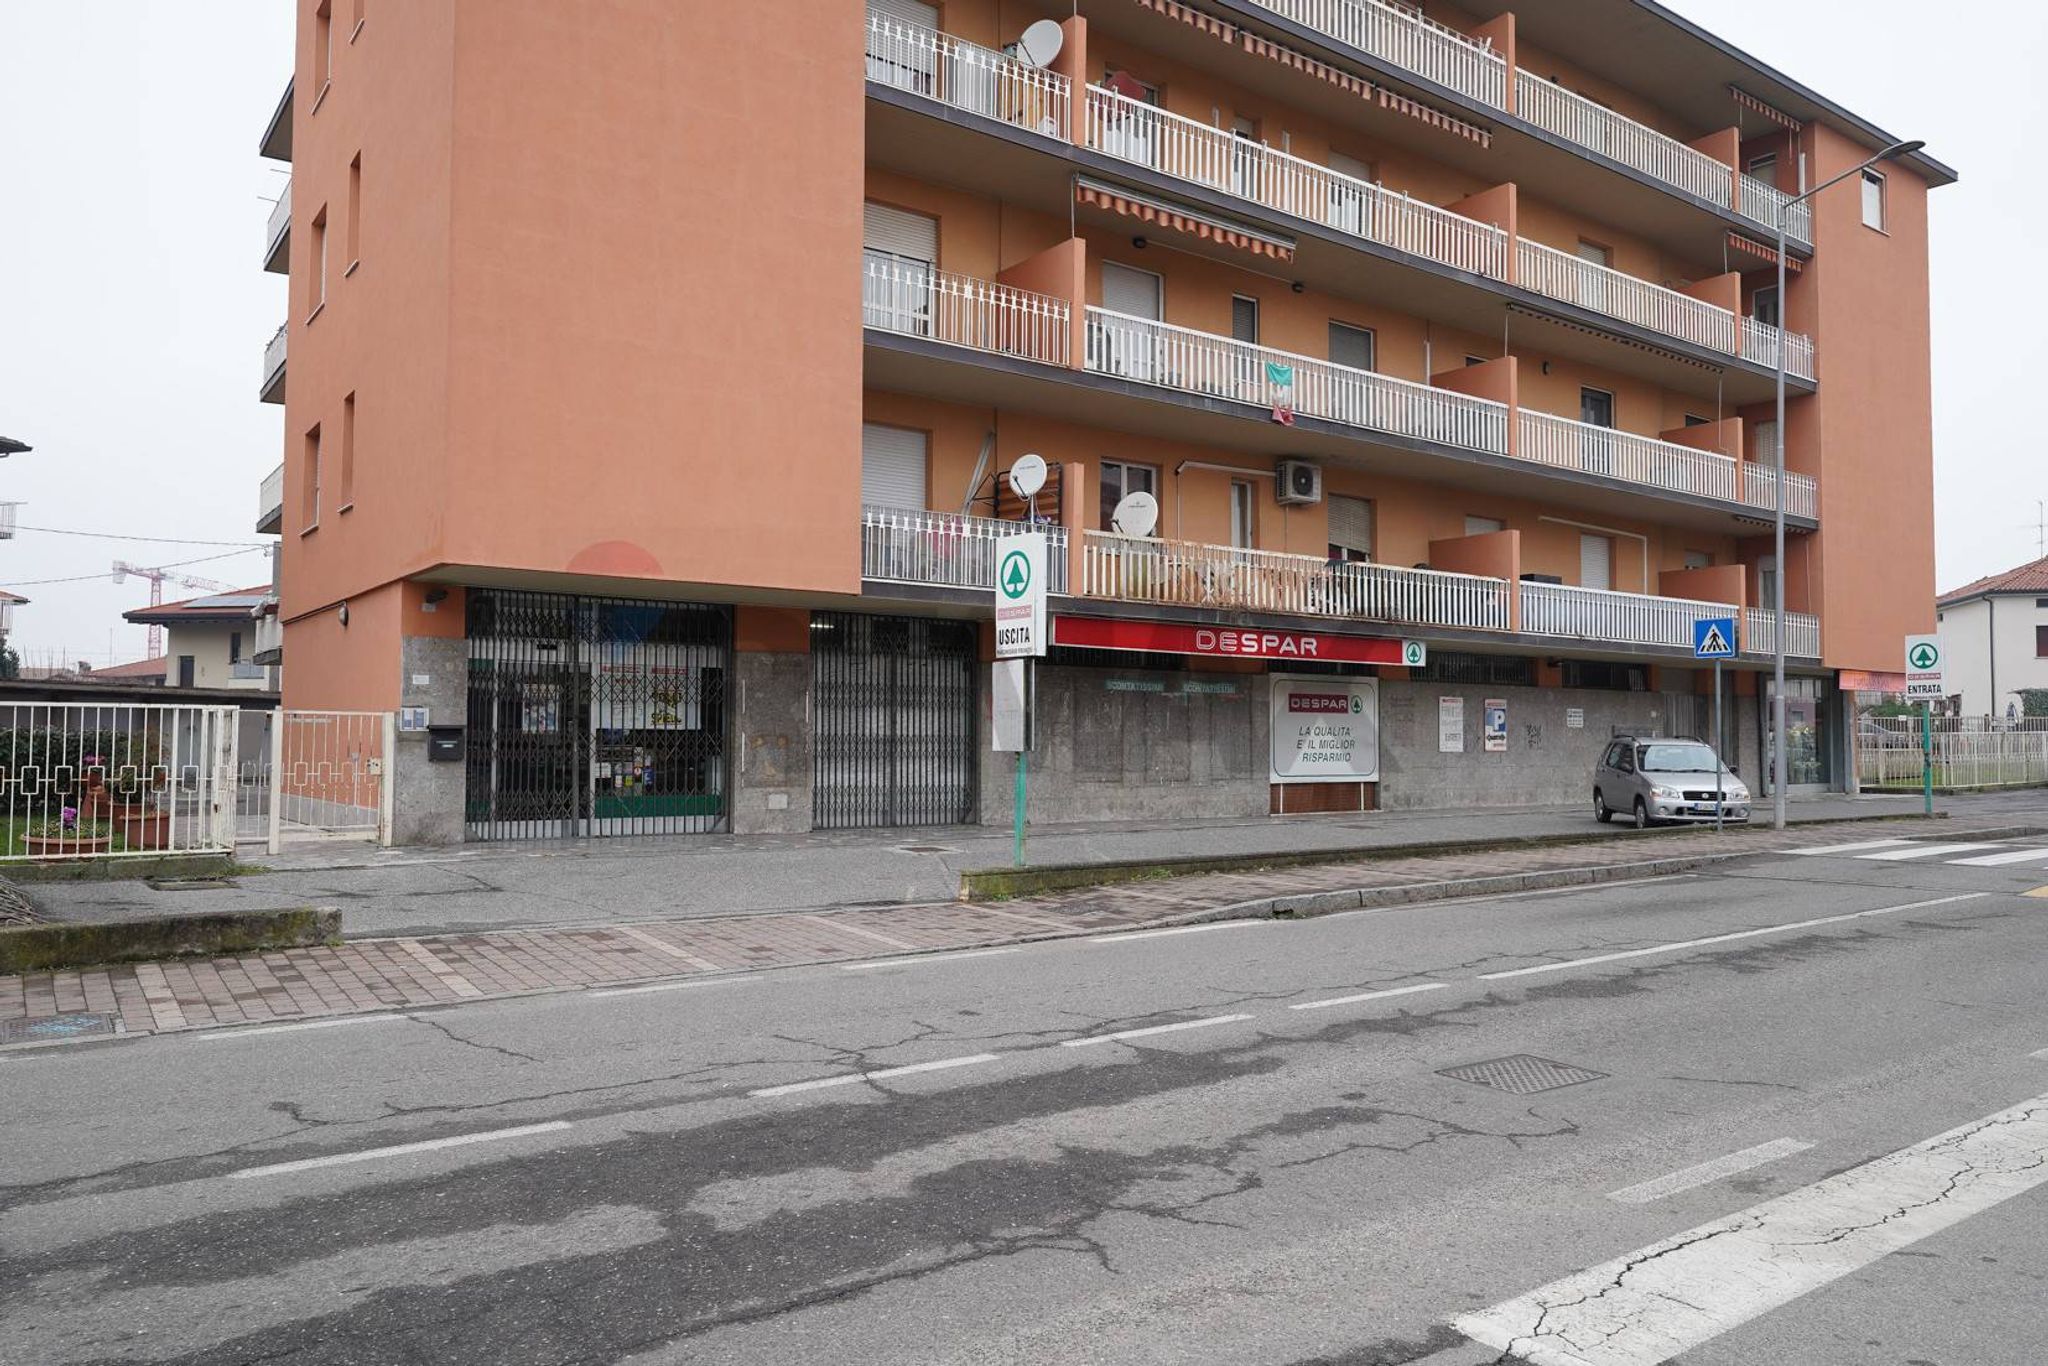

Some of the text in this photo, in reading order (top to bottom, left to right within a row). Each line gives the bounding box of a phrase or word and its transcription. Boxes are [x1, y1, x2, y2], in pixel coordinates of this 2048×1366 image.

[999, 627, 1030, 645] USCITA
[1196, 630, 1318, 656] DESPAR
[1907, 684, 1941, 696] ENTRATA
[1290, 698, 1347, 709] DESPAR
[1298, 726, 1311, 736] LA
[1308, 740, 1316, 749] IL
[1318, 740, 1355, 750] MIGLIOR
[1302, 752, 1352, 763] RISPARMIO
